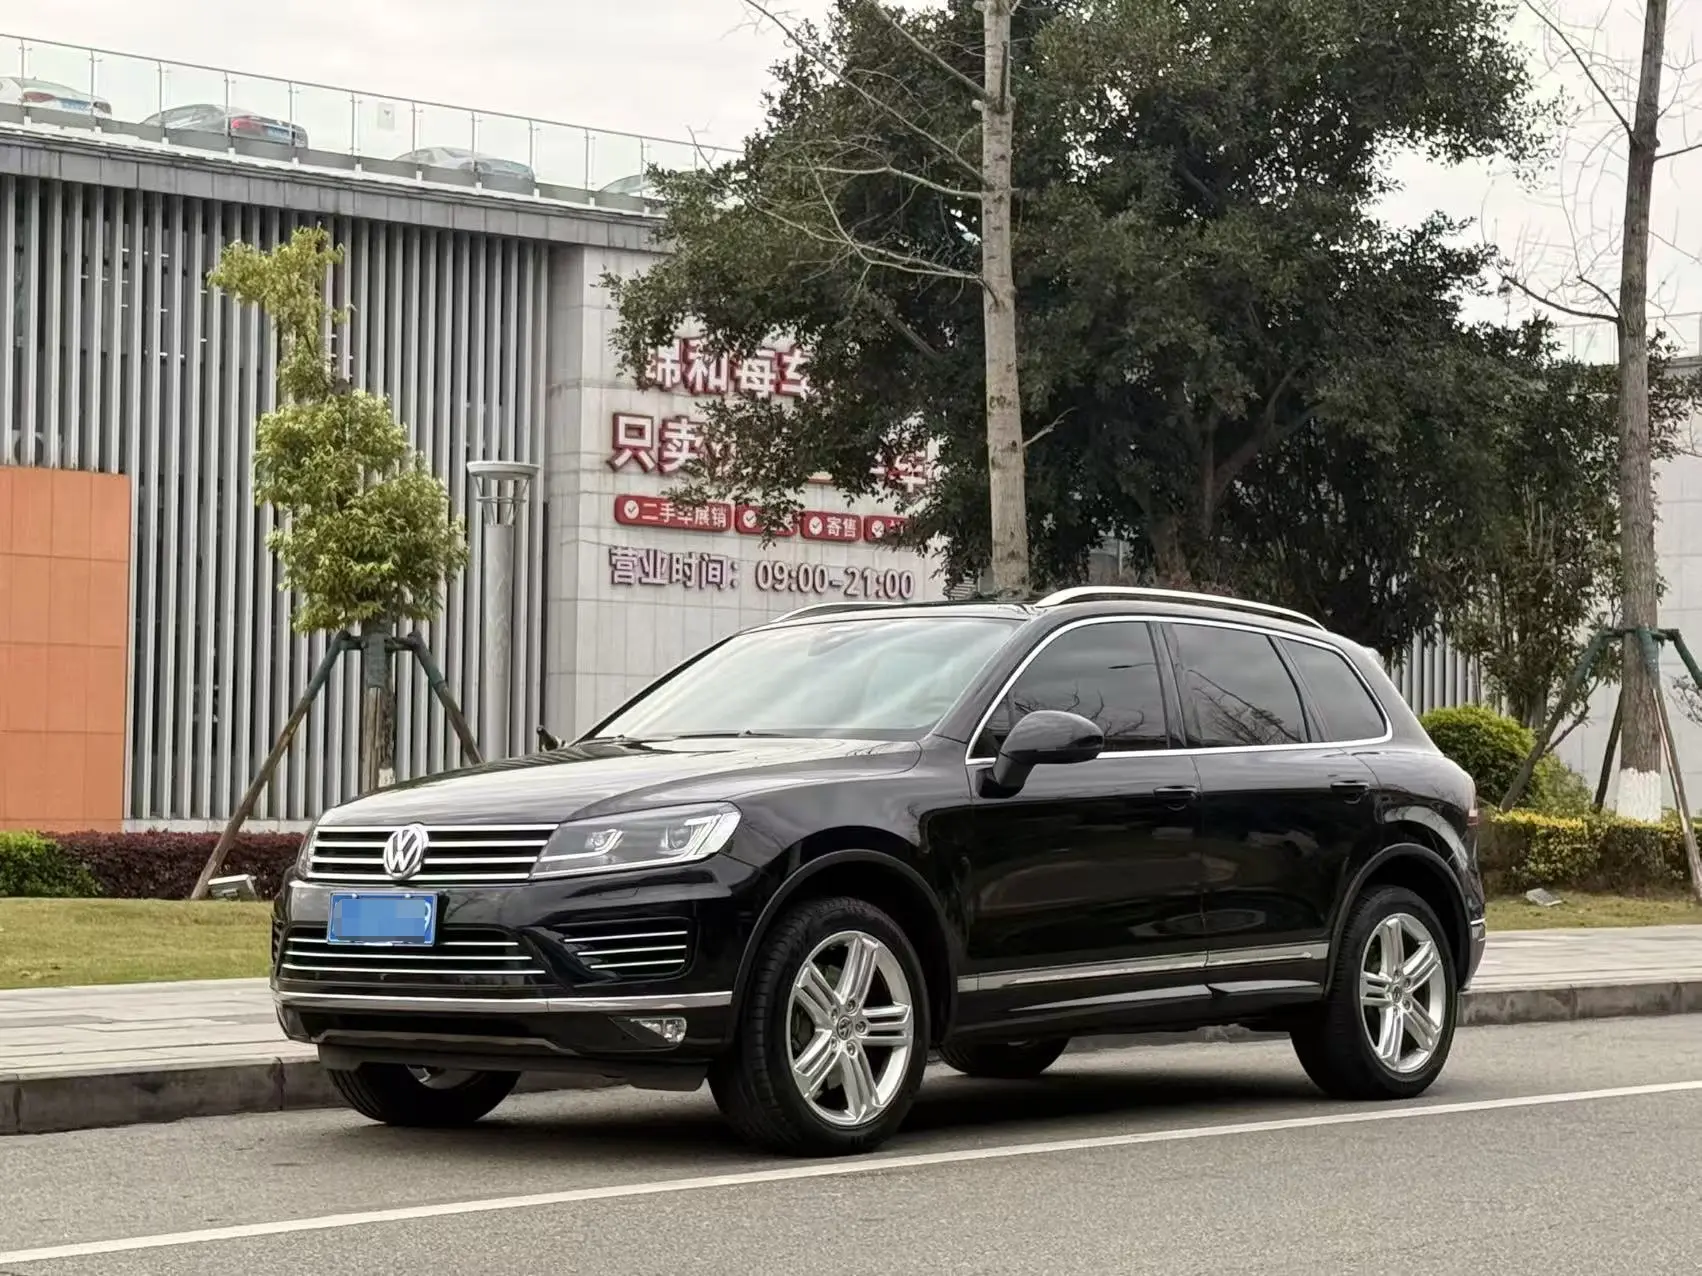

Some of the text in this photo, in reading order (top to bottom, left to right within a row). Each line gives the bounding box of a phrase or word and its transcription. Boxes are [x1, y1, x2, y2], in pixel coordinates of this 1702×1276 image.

[826, 516, 857, 538] 寄售
[609, 547, 916, 599] 营业时间： 09:00-21:00
